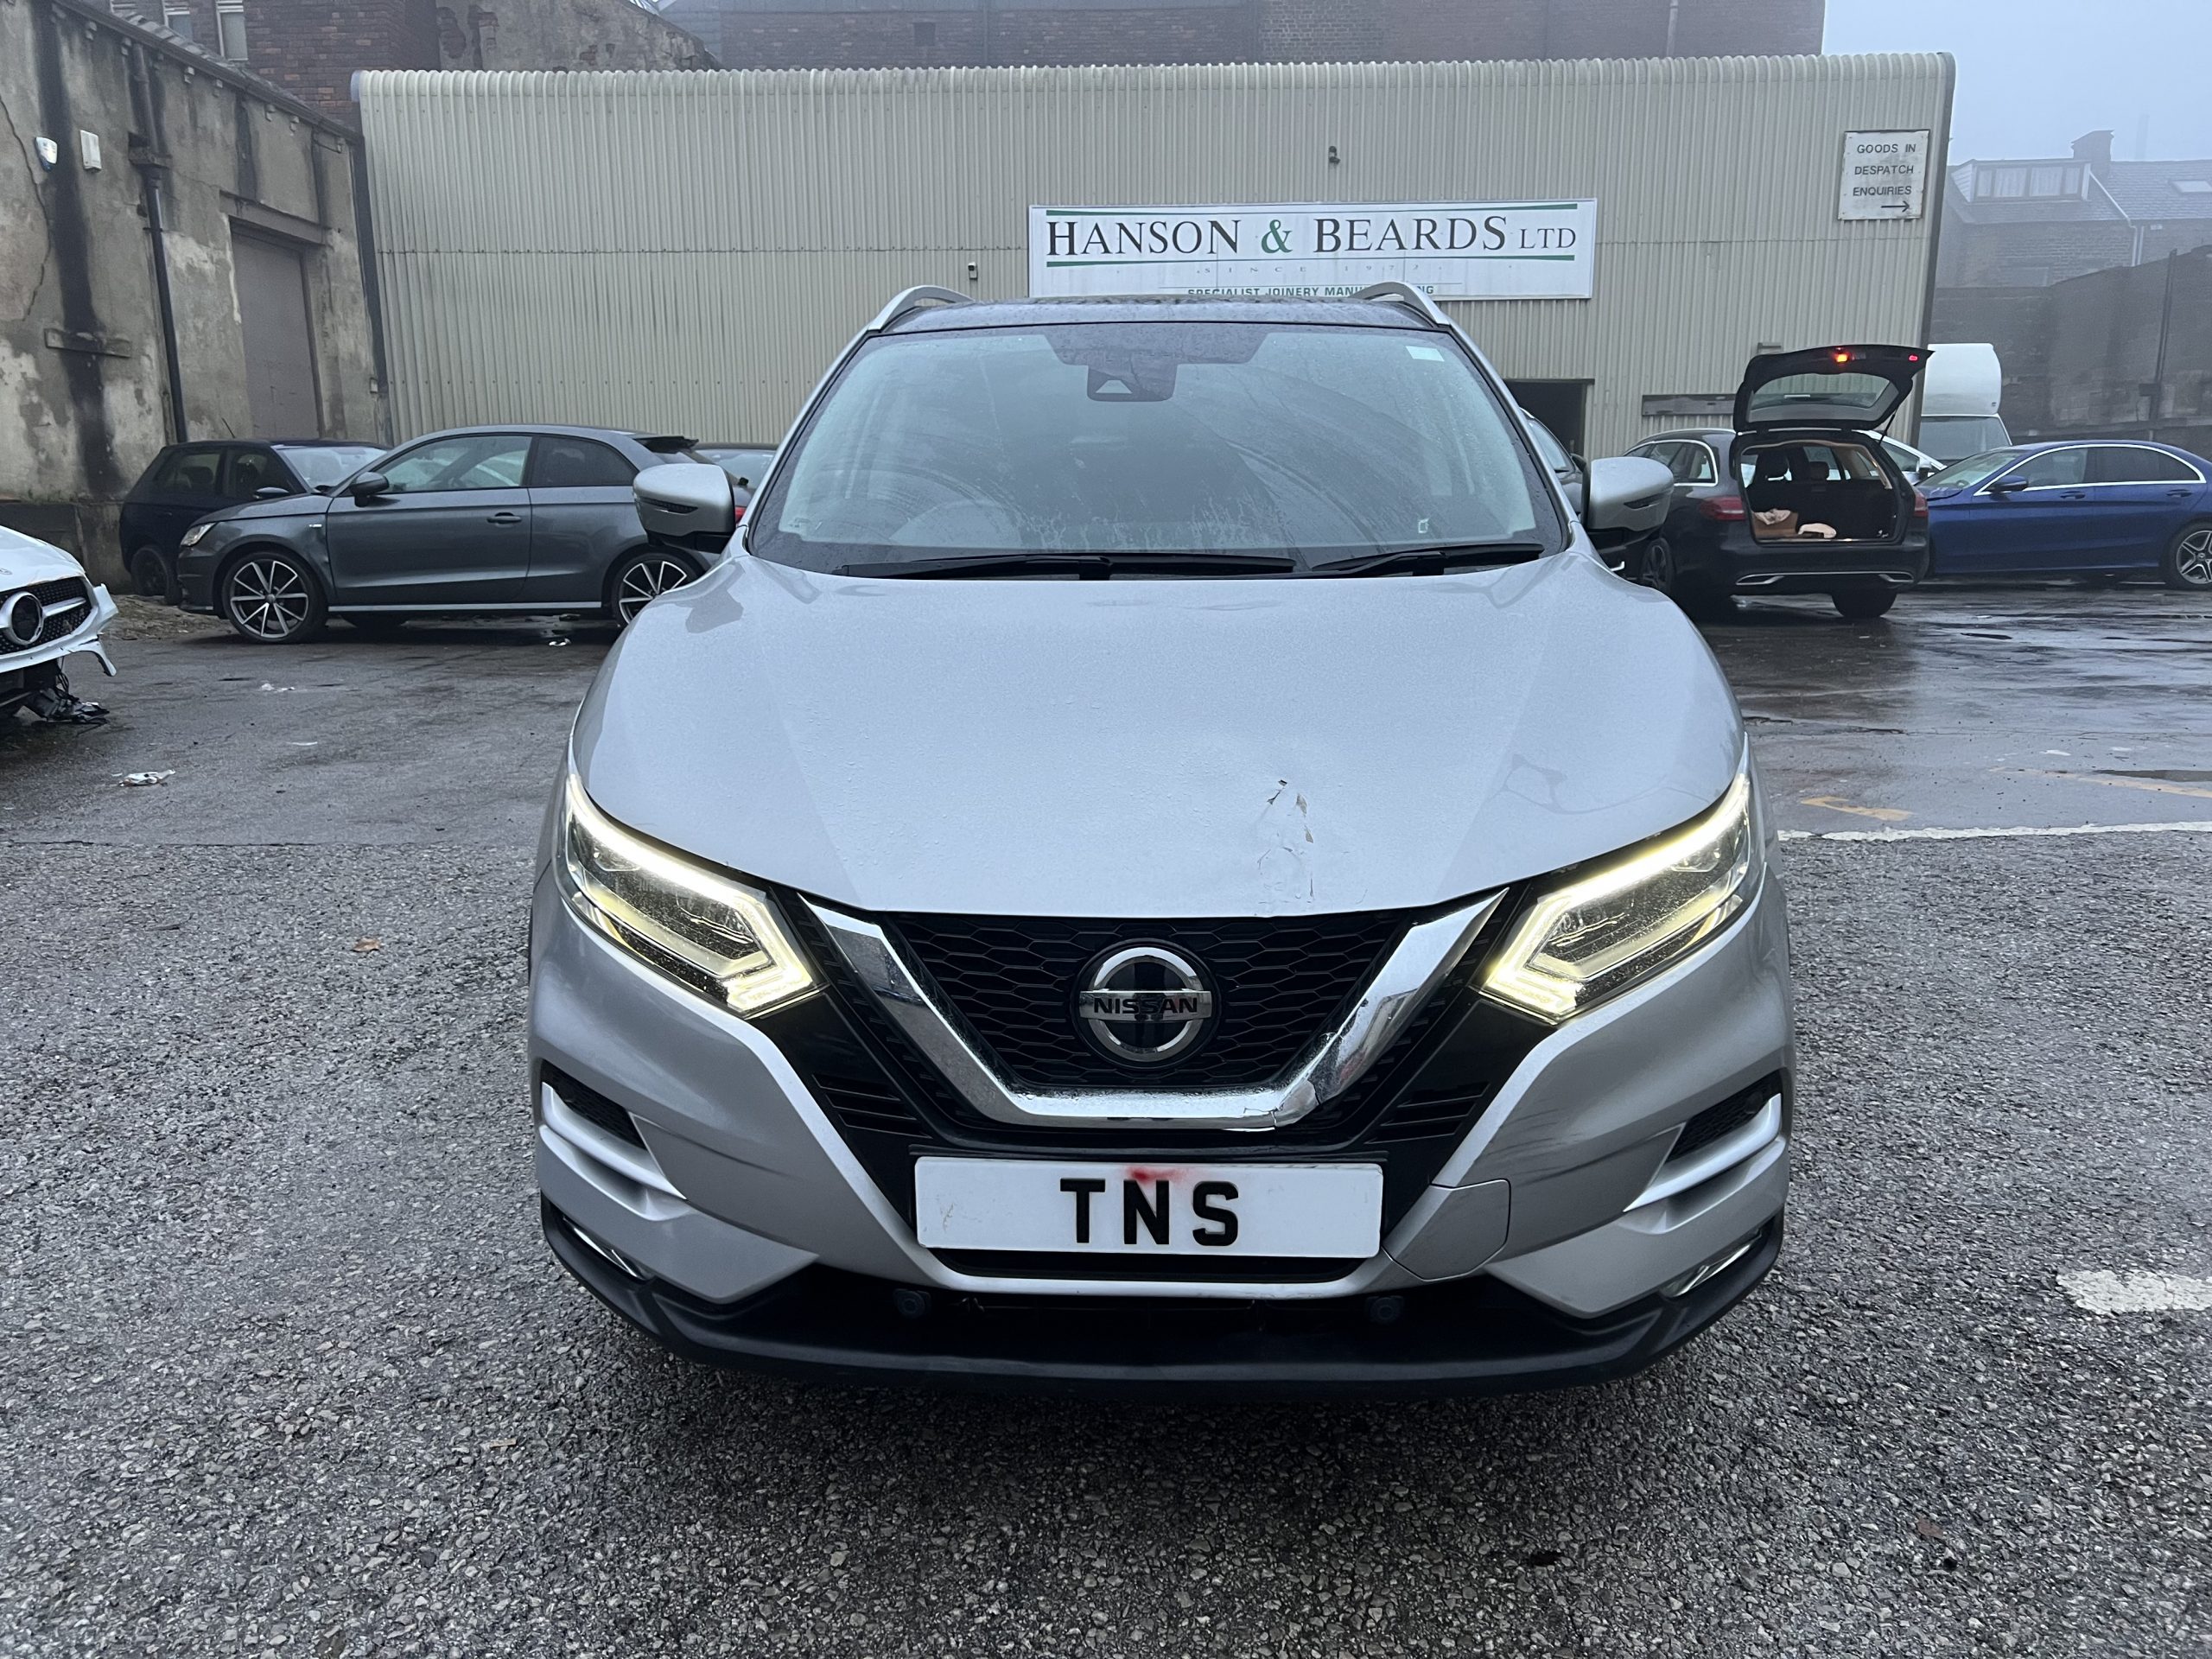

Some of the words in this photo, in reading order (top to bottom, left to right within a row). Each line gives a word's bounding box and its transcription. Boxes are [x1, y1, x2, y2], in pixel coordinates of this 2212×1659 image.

[1857, 143, 1898, 154] GOODS
[1905, 143, 1916, 153] IN
[1854, 165, 1914, 175] DESPATCH
[1853, 186, 1912, 196] ENQUIRIES
[1047, 219, 1242, 257] HANSON
[1261, 219, 1294, 254] &
[1313, 215, 1508, 254] BEARDS
[1519, 227, 1578, 250] LTD
[1265, 287, 1319, 296] JOINERY
[1094, 997, 1198, 1014] NISSAN
[1059, 1177, 1239, 1246] TNS
